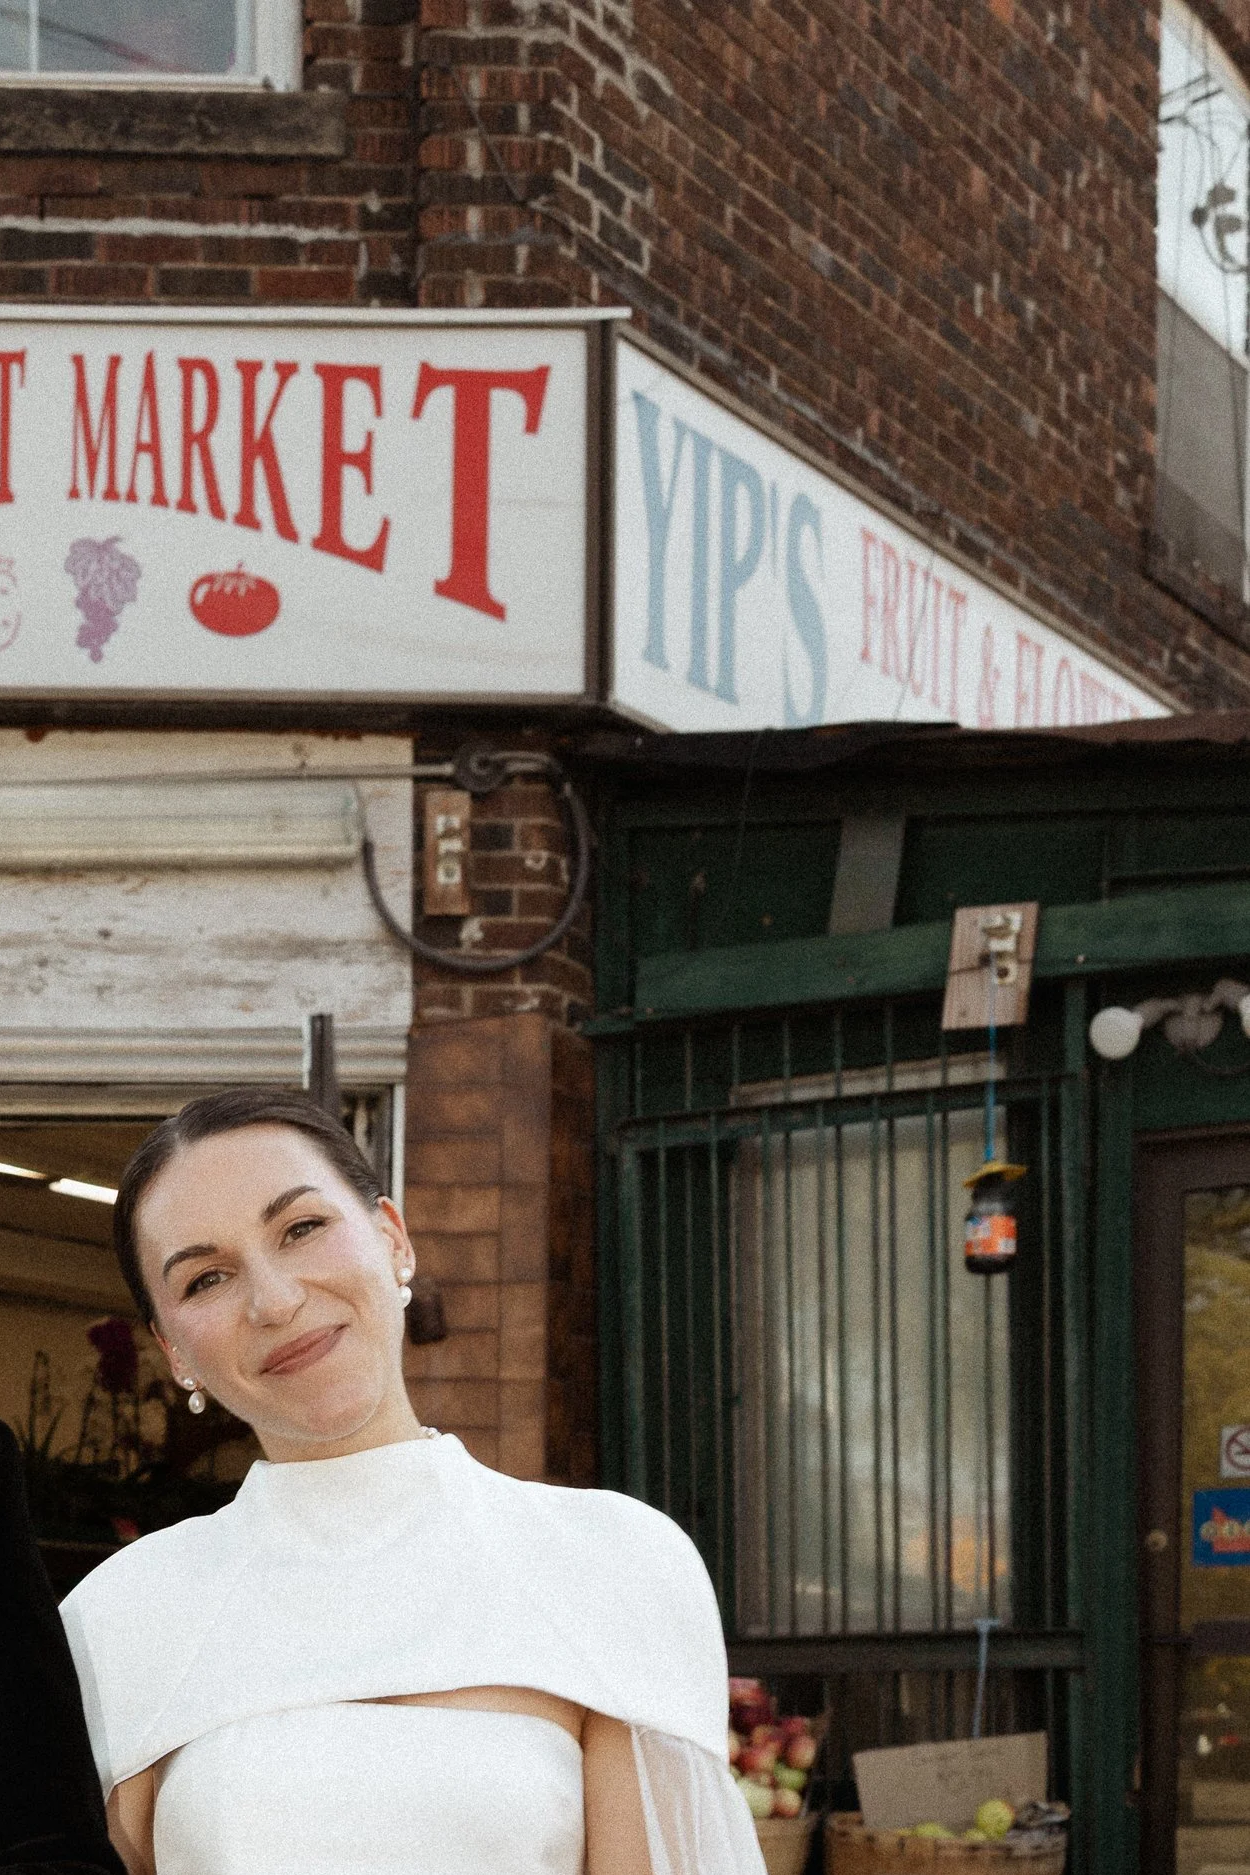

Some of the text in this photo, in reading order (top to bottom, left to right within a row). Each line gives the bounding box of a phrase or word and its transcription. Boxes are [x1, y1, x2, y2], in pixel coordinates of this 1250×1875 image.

[68, 352, 551, 623] MARKET
[631, 389, 830, 726] YIP'S
[859, 524, 968, 724] FRUIT
